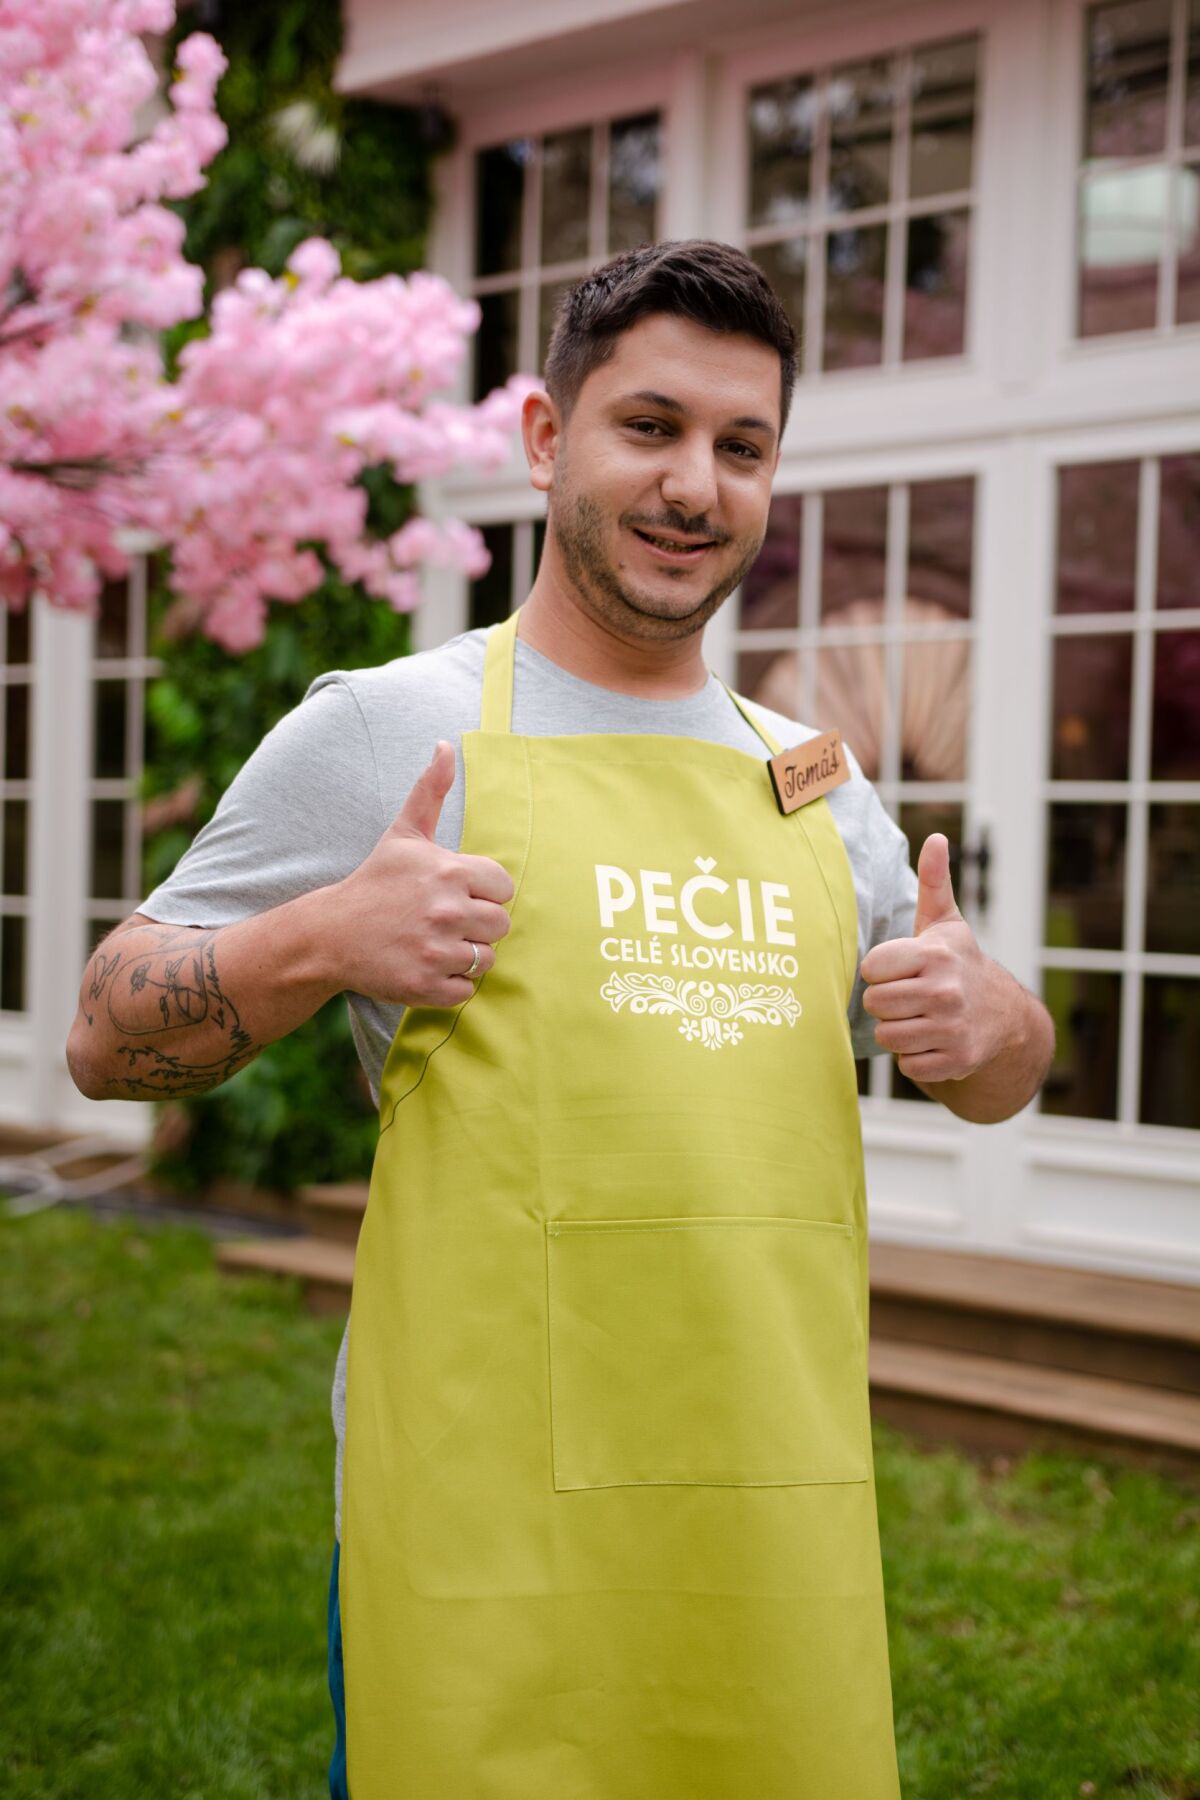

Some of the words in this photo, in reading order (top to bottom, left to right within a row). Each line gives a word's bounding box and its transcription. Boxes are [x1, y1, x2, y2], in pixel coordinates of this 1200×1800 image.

[784, 738, 840, 799] Tomáš
[595, 855, 797, 947] PEČIE
[600, 935, 663, 965] CELÉ
[670, 943, 799, 978] SLOVENSKO
